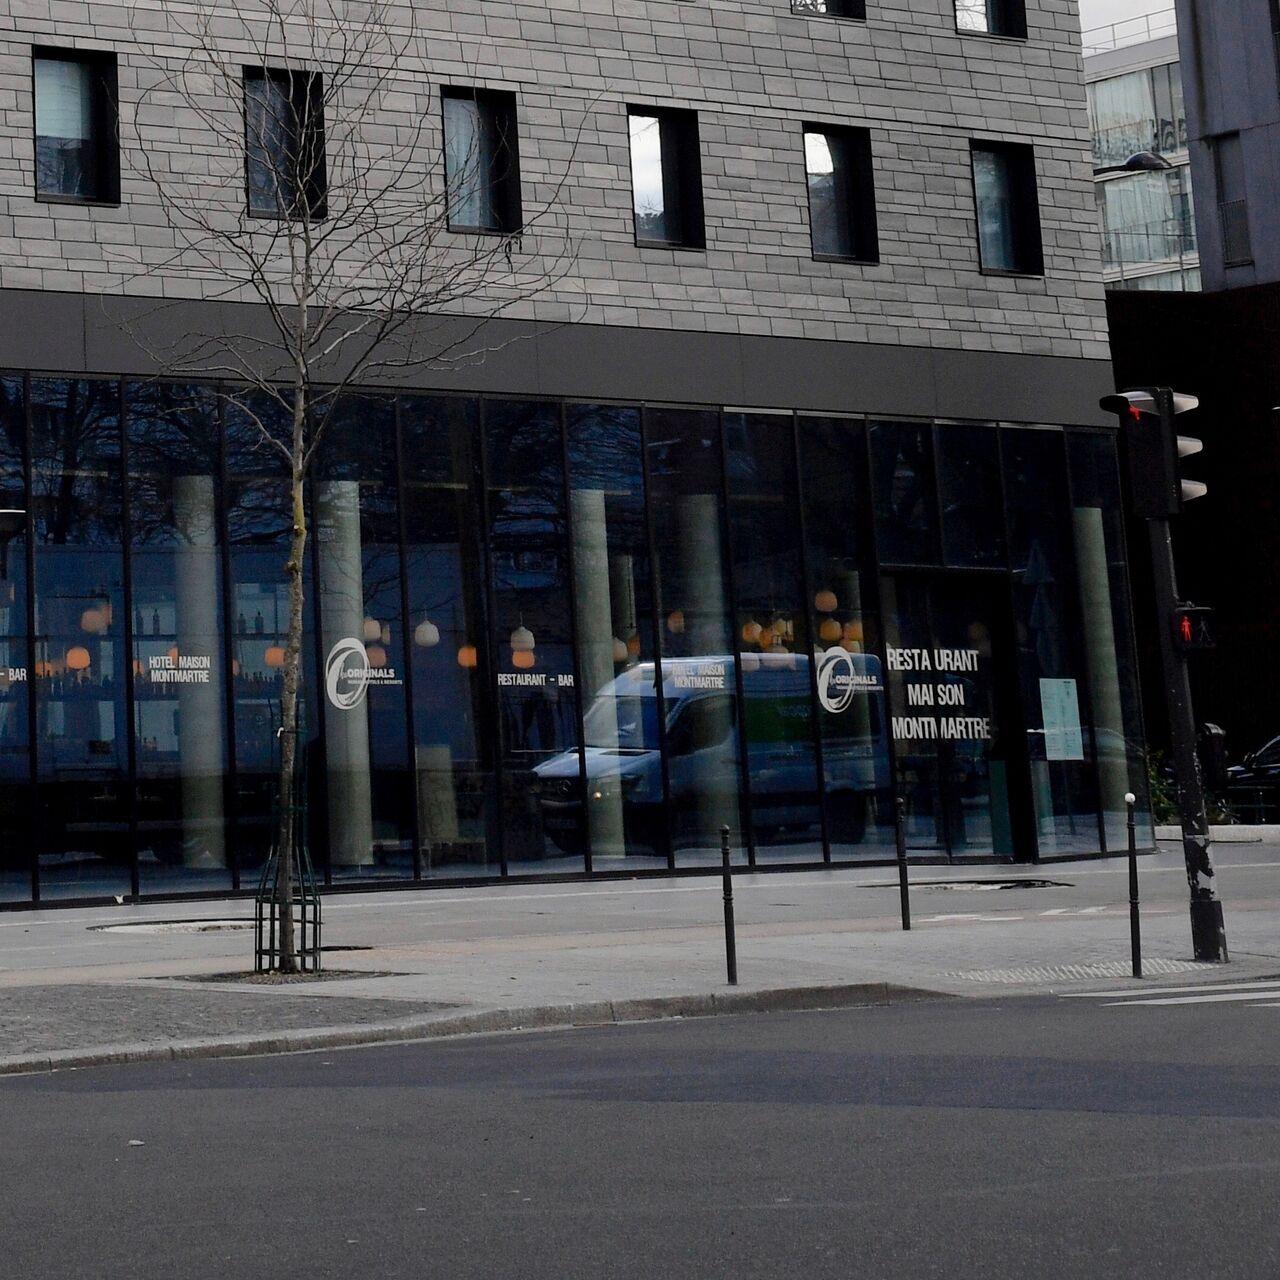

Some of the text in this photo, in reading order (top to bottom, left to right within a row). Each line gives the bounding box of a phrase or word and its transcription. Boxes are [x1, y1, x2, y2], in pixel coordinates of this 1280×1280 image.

[149, 656, 210, 668] HOTEL MAISON
[8, 668, 27, 681] BAR
[151, 670, 209, 683] MONTMARTRE
[347, 668, 395, 678] ORIGINALS
[497, 673, 547, 686] RESTAURANT
[557, 674, 575, 687] BAR
[674, 676, 725, 689] MONTMARTRE
